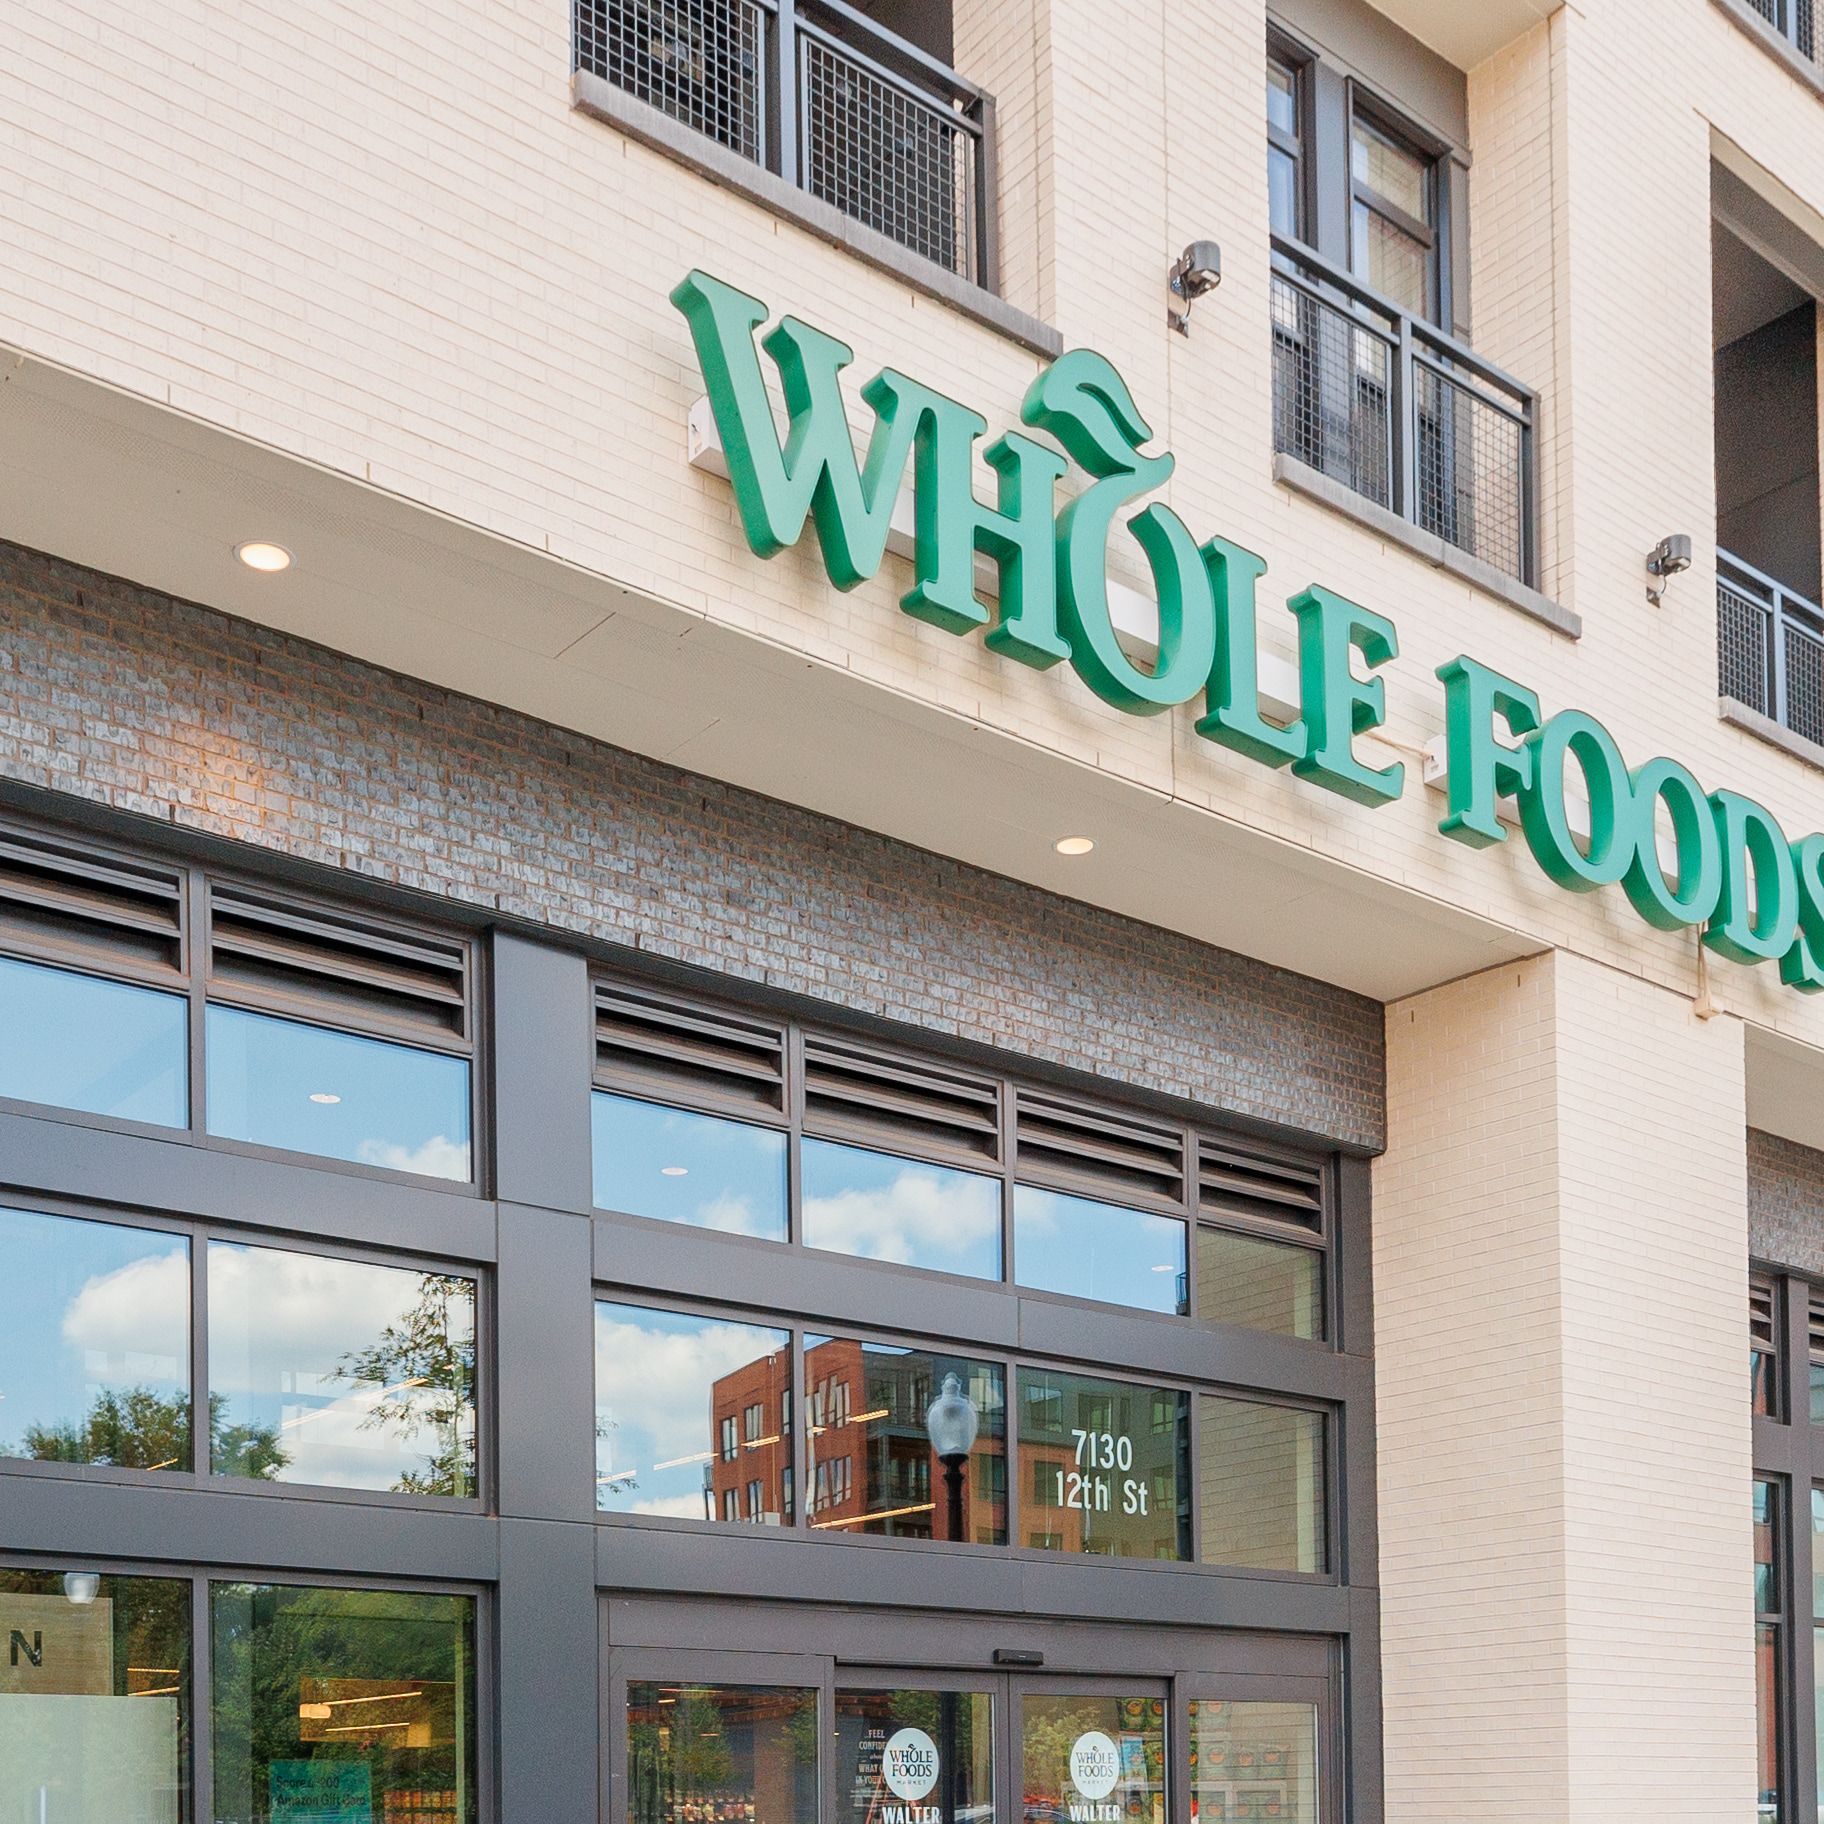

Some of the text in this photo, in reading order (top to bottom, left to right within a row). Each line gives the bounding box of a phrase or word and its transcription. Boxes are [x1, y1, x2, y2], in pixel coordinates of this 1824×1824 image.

[672, 268, 1405, 808] WHOLE
[1071, 1428, 1132, 1471] 7130
[1056, 1470, 1148, 1516] 12th St
[889, 1743, 933, 1763] WHOLE
[1075, 1745, 1114, 1764] WHOLE
[891, 1764, 932, 1778] FOODS
[1078, 1765, 1113, 1778] FOODS
[882, 1806, 940, 1824] WALTER
[1069, 1804, 1121, 1822] WALTER
